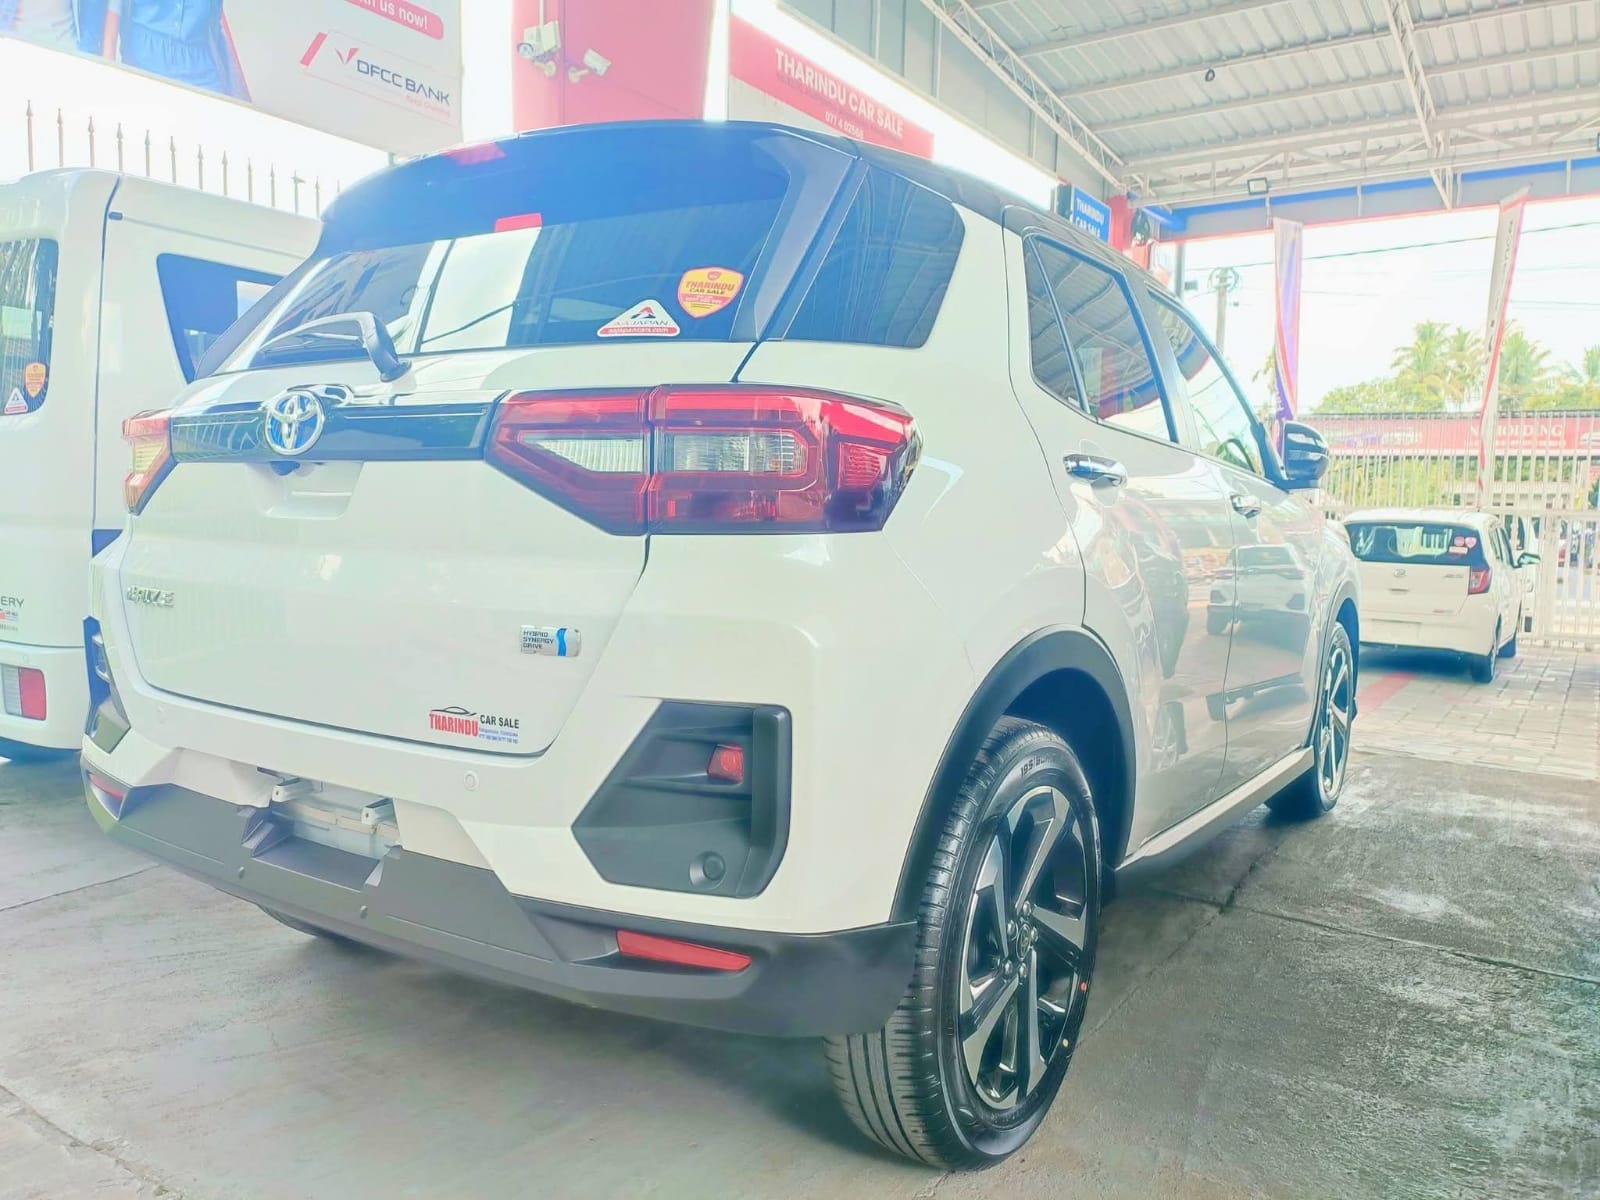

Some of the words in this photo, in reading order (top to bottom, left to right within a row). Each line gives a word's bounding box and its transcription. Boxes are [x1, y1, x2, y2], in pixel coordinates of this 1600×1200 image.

[380, 0, 395, 15] us
[399, 7, 428, 29] now!
[357, 59, 402, 88] DFCC
[405, 78, 450, 106] BANK
[776, 48, 847, 107] THARINDU
[849, 91, 875, 122] CAR
[876, 110, 904, 138] SALE
[686, 281, 736, 291] THARINDU
[523, 630, 549, 638] HYBRID
[523, 636, 554, 644] SYNERGY
[523, 642, 543, 650] DRIVE
[429, 713, 478, 737] THARINDU
[480, 714, 497, 726] CAR
[498, 717, 520, 729] SALE
